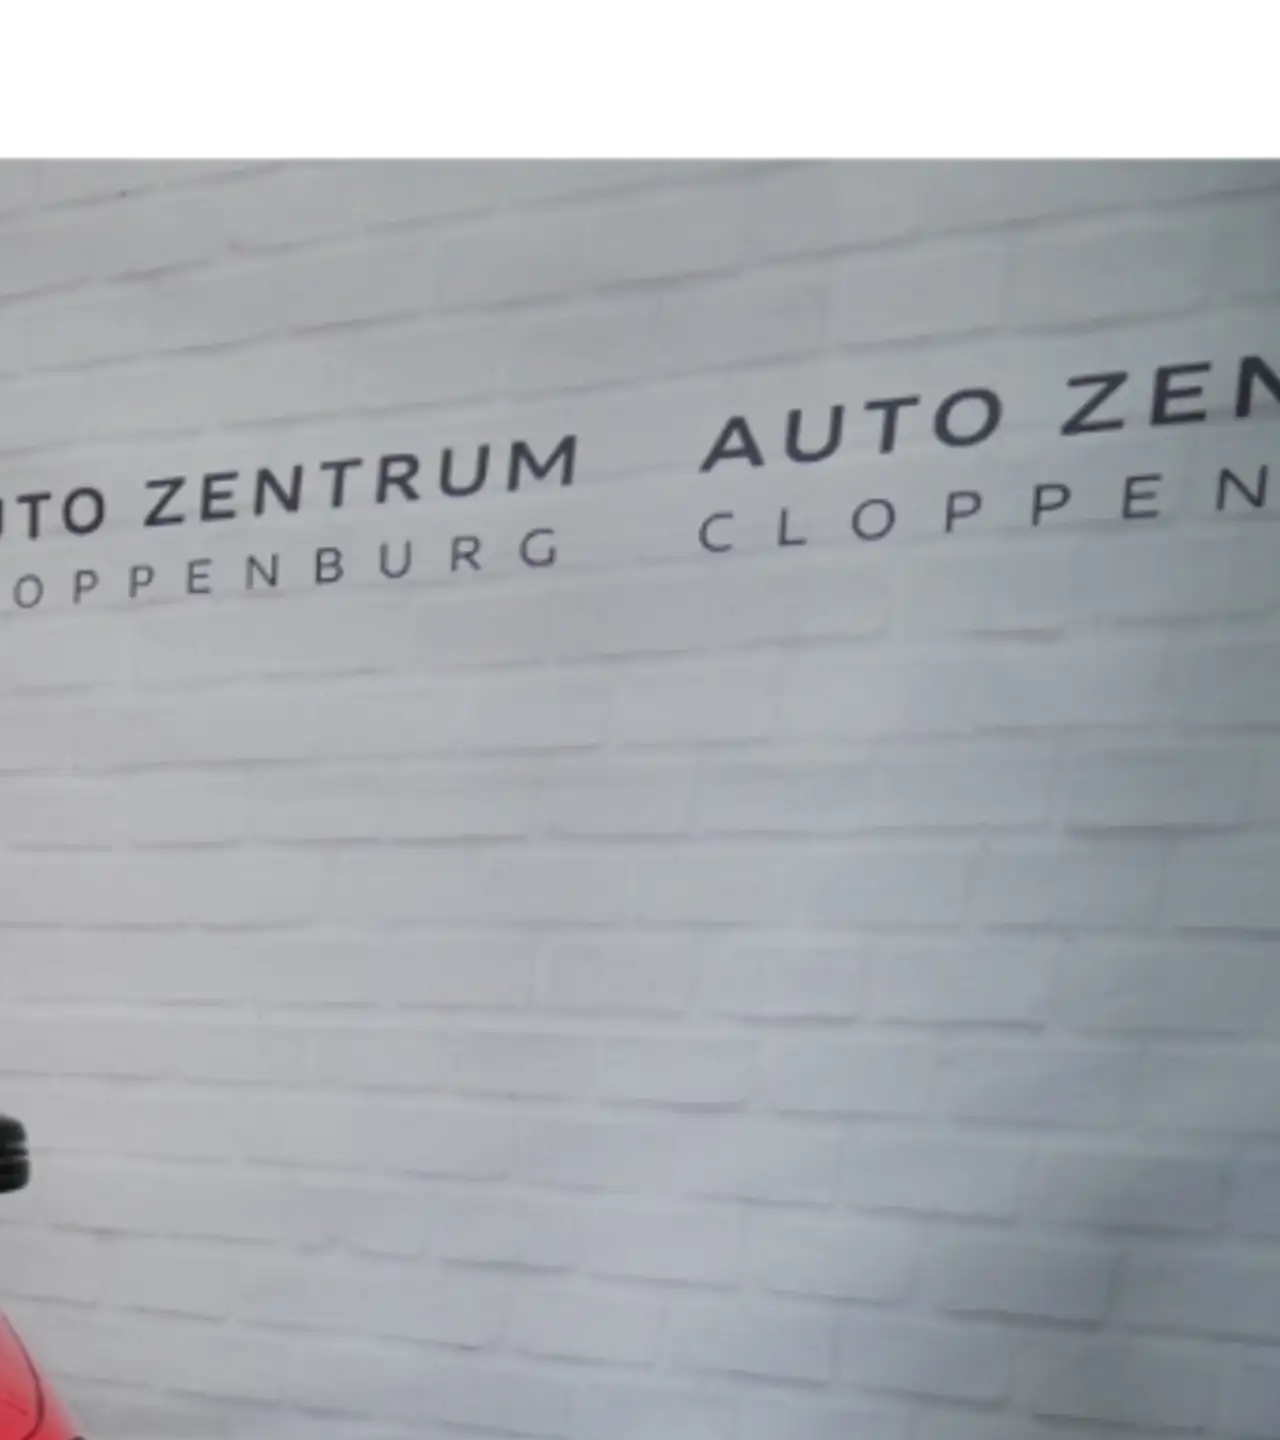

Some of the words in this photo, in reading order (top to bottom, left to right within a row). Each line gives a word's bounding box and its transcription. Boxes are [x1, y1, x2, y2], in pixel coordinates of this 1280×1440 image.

[698, 385, 1004, 474] AUTO
[141, 433, 579, 529] ZENTRUM
[698, 463, 1270, 554] CLOPPEN
